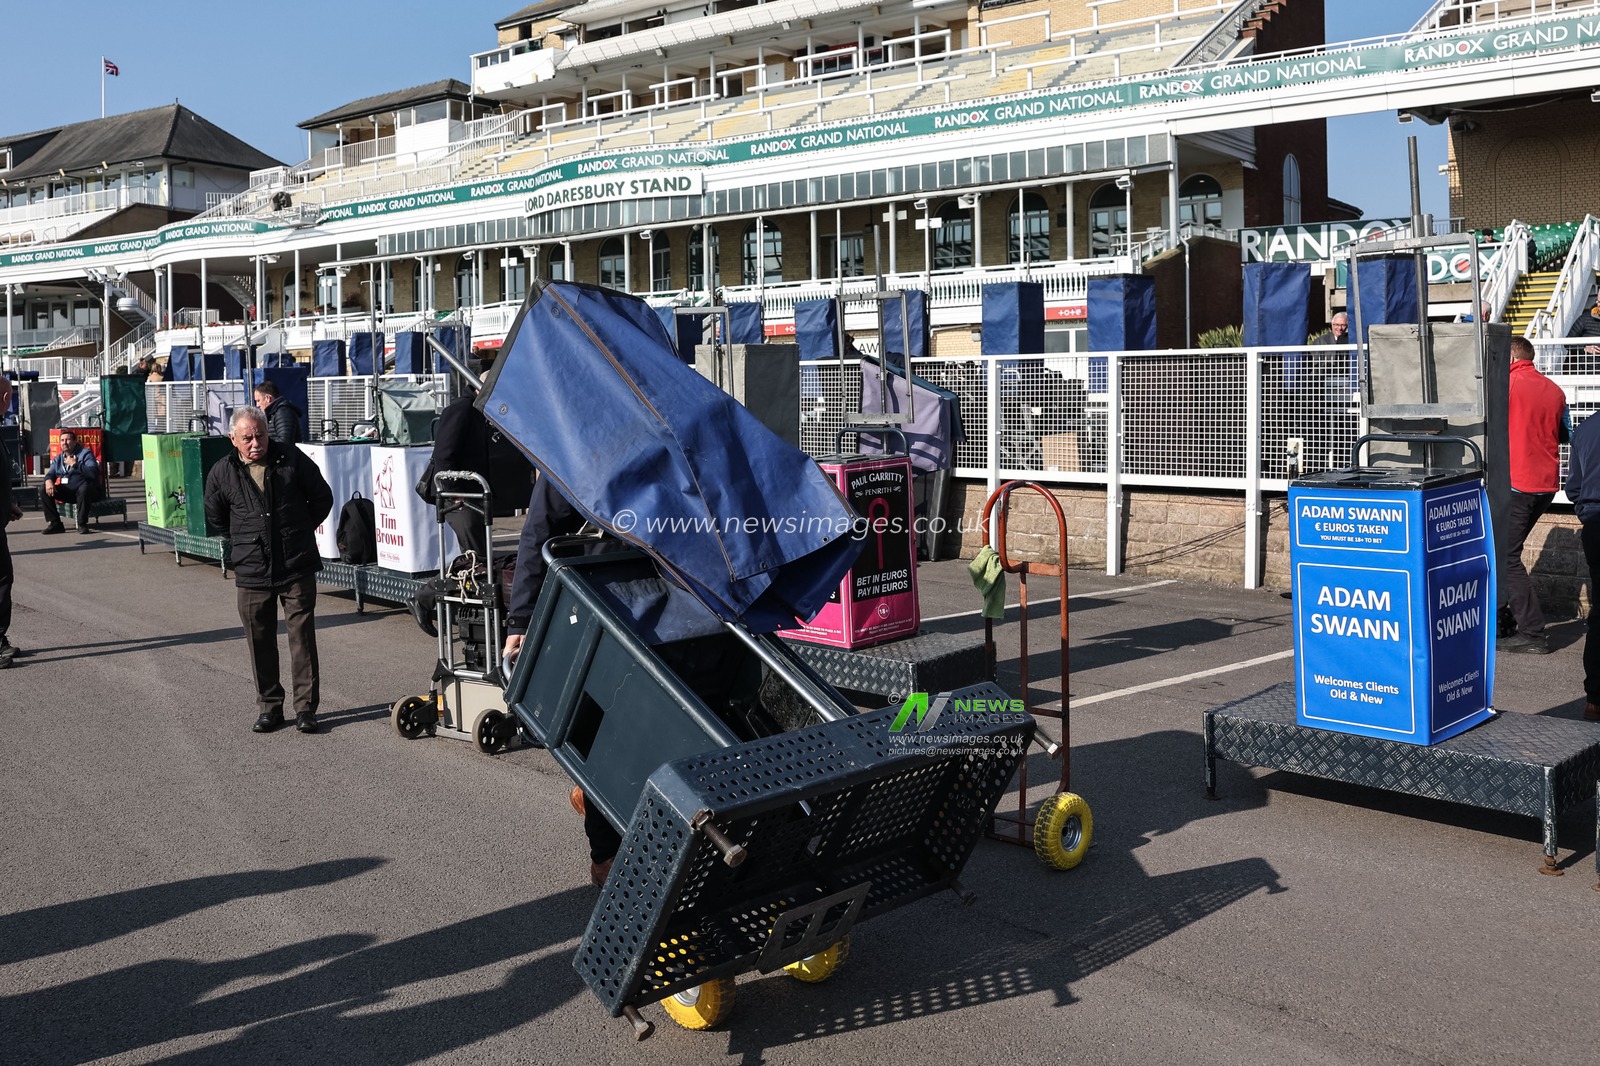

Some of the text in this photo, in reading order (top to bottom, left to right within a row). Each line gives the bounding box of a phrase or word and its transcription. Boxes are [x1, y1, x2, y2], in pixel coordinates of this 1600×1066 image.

[1405, 38, 1484, 63] RANDOX
[1493, 26, 1568, 50] GRAND
[1139, 55, 1366, 99] RANDOX GRAND NATIONAL
[934, 89, 1124, 128] RANDOX GRAND NATIONAL
[750, 122, 909, 156] RANDOX GRAND NATIONAL
[578, 149, 729, 174] RANDOX GRAND NATIONAL
[471, 168, 563, 198] RANDOX GRAND NATIONAL
[358, 191, 456, 214] RANDOX GRAND NATIONAL
[525, 176, 692, 212] LORD DARESBURY STAND
[185, 224, 209, 237] GRAND
[211, 222, 254, 234] NATIONAL
[12, 254, 34, 263] RANDOX
[35, 252, 55, 261] GRAND
[56, 248, 84, 258] NATIONAL
[94, 244, 118, 254] RANDOX
[120, 240, 142, 250] GRAND
[851, 472, 904, 490] PAUL GARRITTY
[864, 488, 892, 496] PENRITH
[1301, 505, 1402, 522] ADAM SWANN
[1428, 498, 1478, 520] ADAM SWANN
[380, 513, 396, 530] Tim
[1314, 522, 1388, 534] € EUROS TAKEN
[1440, 520, 1457, 532] EUROS
[1458, 516, 1472, 527] TAKEN
[376, 528, 404, 546] Brown
[856, 569, 908, 586] BET IN EUROS
[857, 580, 908, 598] PAY IN EUROS
[1318, 586, 1391, 612] ADAM
[1438, 580, 1478, 610] ADAM
[1310, 613, 1400, 642] SWANN
[1436, 606, 1480, 640] SWANN
[1314, 674, 1399, 695] Welcomes Clients
[1438, 669, 1480, 694] Welcomes Clients
[1330, 689, 1383, 704] Old & New
[1446, 684, 1473, 703] Old & New
